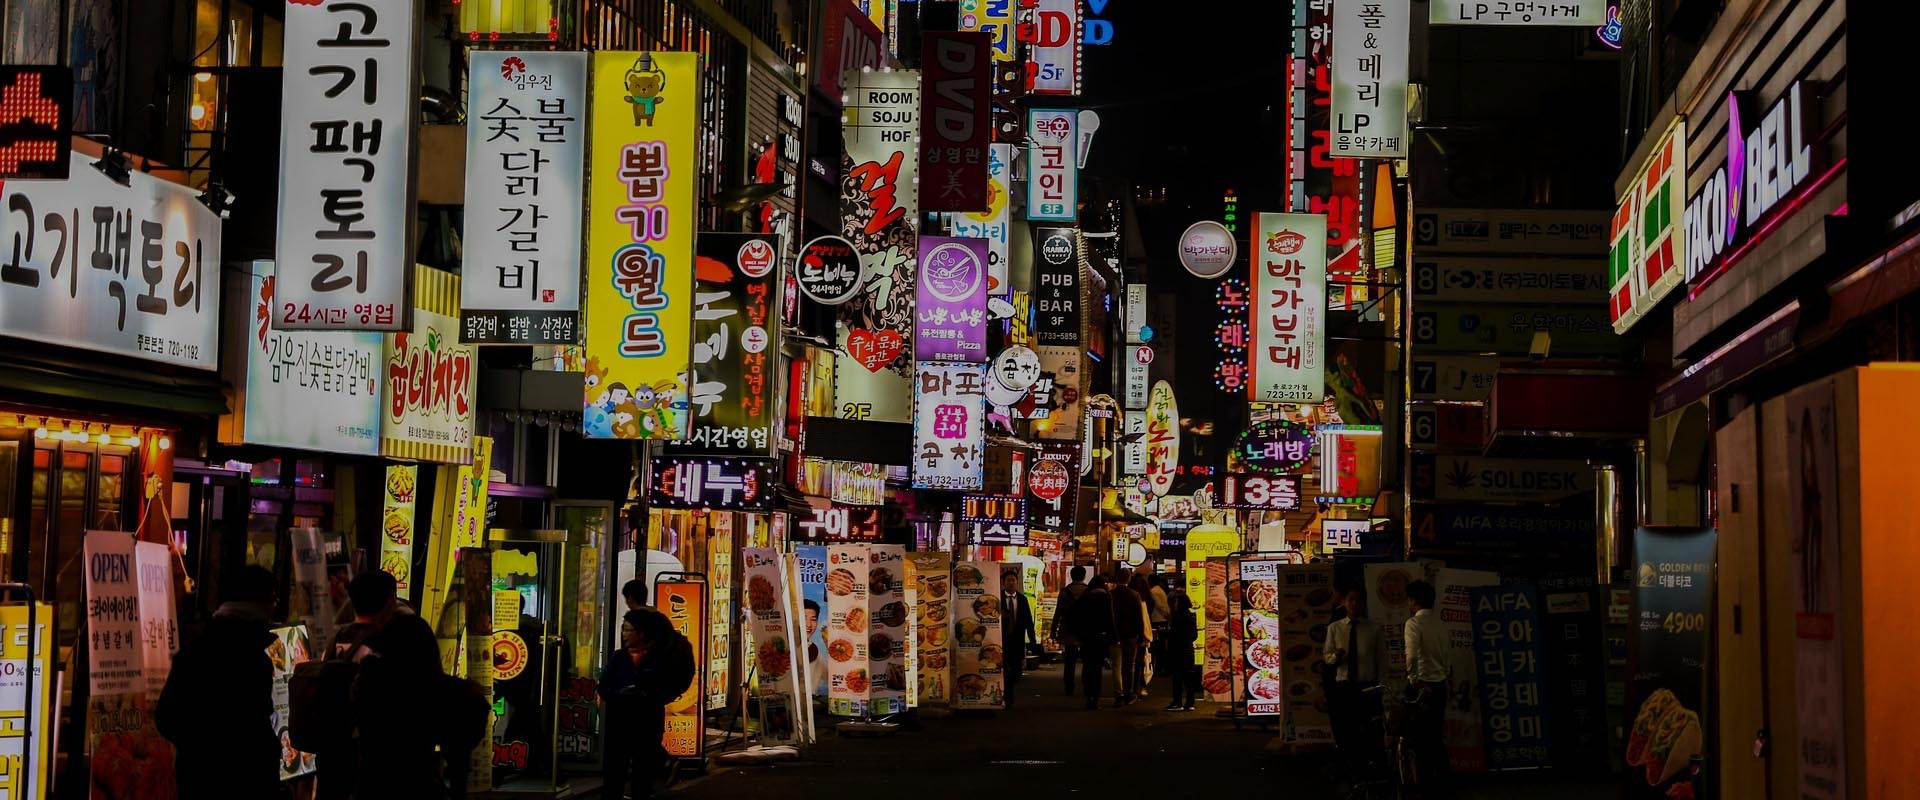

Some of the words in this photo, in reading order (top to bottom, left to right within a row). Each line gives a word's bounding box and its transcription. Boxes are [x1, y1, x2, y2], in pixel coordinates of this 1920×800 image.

[1460, 4, 1488, 20] LP
[1494, 1, 1580, 22] 구멍가게
[513, 74, 552, 90] 김우진
[1040, 63, 1064, 80] 5F
[869, 92, 912, 104] ROOM
[936, 37, 977, 143] DVD
[480, 98, 575, 143] 숯불
[872, 110, 912, 124] SOJU
[1338, 114, 1370, 134] LP
[881, 130, 911, 142] HOF
[1337, 136, 1400, 152] 음악카페
[309, 3, 390, 294] 고기팩토리
[1040, 146, 1064, 200] 코인
[1682, 166, 1728, 285] TACO
[1746, 80, 1811, 228] BELL
[496, 148, 549, 301] 닭갈비
[1418, 218, 1434, 240] 9
[616, 145, 665, 353] 뽑기월드
[1185, 246, 1230, 256] 박가부대
[1, 193, 79, 299] 고기
[91, 205, 202, 332] 팩토리
[1041, 274, 1073, 286] PUB
[1418, 267, 1434, 290] 8
[1053, 289, 1060, 297] &
[284, 302, 348, 325] 24시간
[353, 303, 394, 325] 영업
[1040, 300, 1073, 312] BAR
[1267, 259, 1306, 370] 박가부대
[466, 315, 498, 340] 닭갈비
[508, 315, 532, 339] 닭발
[540, 315, 573, 339] 삼겹살
[1051, 317, 1065, 325] 3F
[1417, 316, 1434, 340] 8
[956, 340, 981, 350] Pizza
[1223, 285, 1244, 390] 노래방
[168, 340, 199, 360] 720-1192
[269, 334, 371, 396] 김우진숯불닭갈비
[1003, 359, 1038, 380] 곱창
[921, 371, 983, 397] 마포
[1418, 365, 1432, 390] 7
[1266, 390, 1314, 400] 723-2112
[843, 402, 871, 420] 2F
[1416, 415, 1431, 440] 6
[920, 442, 979, 469] 곱창
[1037, 450, 1072, 463] Luxury
[1245, 440, 1306, 462] 노래방
[935, 475, 977, 486] 732-1197
[1030, 477, 1067, 489] 羊肉串
[1481, 470, 1577, 490] SOLDESK
[965, 501, 1015, 520] DVD
[1453, 516, 1494, 530] AIFA
[92, 553, 130, 584] OPEN
[141, 564, 169, 593] OPEN
[1257, 564, 1278, 573] 고기
[1659, 563, 1689, 573] GOLDEN
[1676, 576, 1692, 588] 타코
[1477, 592, 1532, 613] AIFA
[1663, 611, 1704, 635] 4900
[91, 630, 133, 650] 양념갈비
[1481, 620, 1514, 743] 우리경영
[1508, 618, 1543, 740] 아카데미
